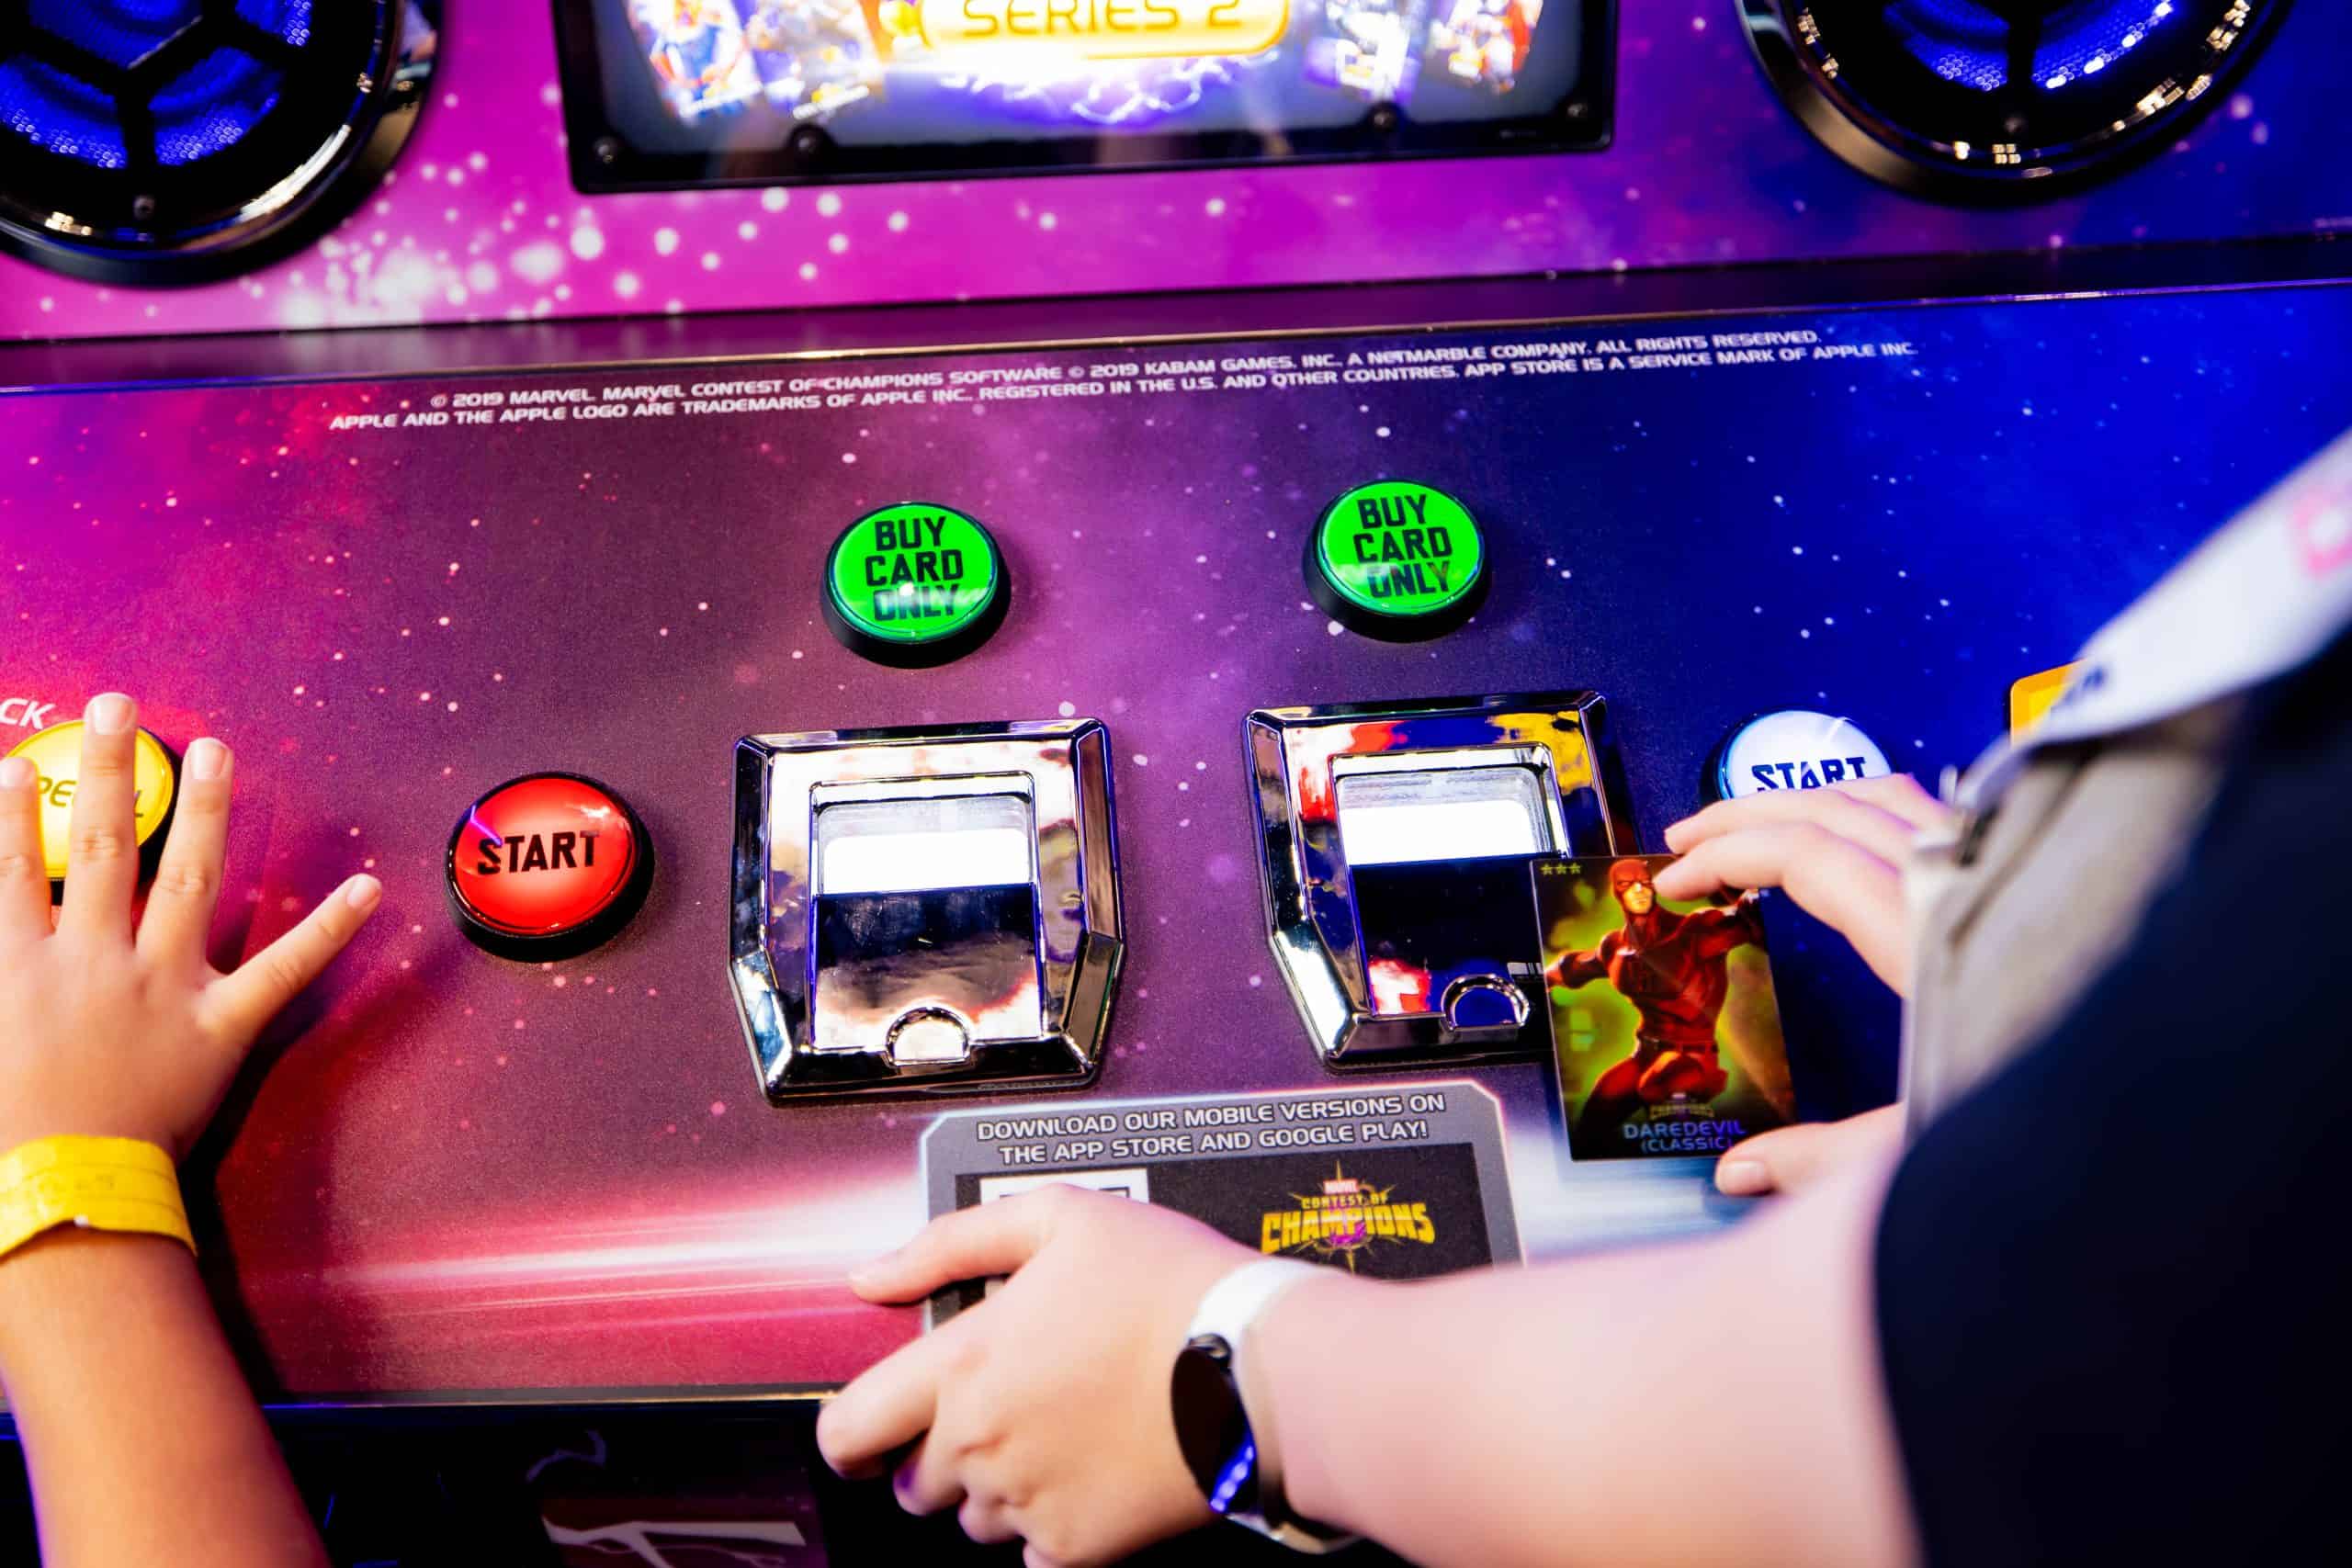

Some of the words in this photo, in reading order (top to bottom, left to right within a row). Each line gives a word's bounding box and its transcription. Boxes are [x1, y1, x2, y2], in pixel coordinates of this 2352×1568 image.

[963, 0, 1182, 38] SERIES
[1205, 0, 1245, 30] 2
[330, 413, 398, 430] APPLE
[403, 411, 449, 427] AND
[453, 409, 494, 424] THE
[500, 406, 568, 422] APPLE
[572, 403, 628, 419] LOGO
[633, 401, 676, 417] ARE
[682, 395, 821, 413] TRADEMARKS
[827, 393, 856, 409] OF
[861, 389, 927, 406] APPLE
[979, 381, 1104, 401] REGISTERED
[1110, 379, 1132, 395] IN
[1136, 378, 1177, 393] THE
[1181, 376, 1218, 391] U.S.
[1223, 373, 1268, 389] AND
[1271, 370, 1339, 388] OTHER
[1464, 361, 1506, 378] APP
[1510, 358, 1578, 376] STORE
[1582, 356, 1604, 372] IS
[1609, 355, 1625, 370] A
[1628, 352, 1713, 368] SERVICE
[1716, 347, 1775, 364] MARK
[1779, 345, 1808, 361] OF
[1813, 344, 1877, 359] APPLE
[453, 391, 504, 408] 2019
[603, 384, 686, 401] MARVEL
[691, 379, 784, 397] CONTEST
[789, 378, 816, 394] OF
[823, 372, 944, 390] CHAMPIONS
[949, 367, 1062, 385] SOFTWARE
[1090, 363, 1138, 378] 2019
[1145, 359, 1216, 376] KABAM
[1347, 352, 1363, 367] A
[1367, 346, 1487, 365] NETMARBLE
[1596, 338, 1632, 354] ALL
[1635, 335, 1709, 352] RIGHTS
[1357, 494, 1427, 529] BUY
[875, 516, 946, 551] BUY
[1353, 526, 1453, 564] CARD
[865, 549, 964, 587] CARD
[1367, 560, 1450, 598] ONLY
[874, 583, 960, 621] ONLY
[1751, 756, 1866, 792] START
[477, 830, 600, 875] START
[977, 1114, 1117, 1141] DOWNLOAD
[1125, 1111, 1177, 1131] OUR
[1184, 1104, 1274, 1127] MOBILE
[1279, 1096, 1402, 1121] VERSIONS
[1408, 1093, 1445, 1112] ON
[1623, 1120, 1747, 1139] DAREDEVIL
[999, 1145, 1046, 1166] THE
[1053, 1140, 1103, 1162] APP
[1111, 1134, 1193, 1158] STORE
[1200, 1131, 1251, 1152] AND
[1259, 1124, 1354, 1148] GOOGLE
[1362, 1120, 1429, 1142] PLAY!
[1301, 1193, 1363, 1209] CONTEST
[1261, 1202, 1435, 1255] CHAMPIONS
